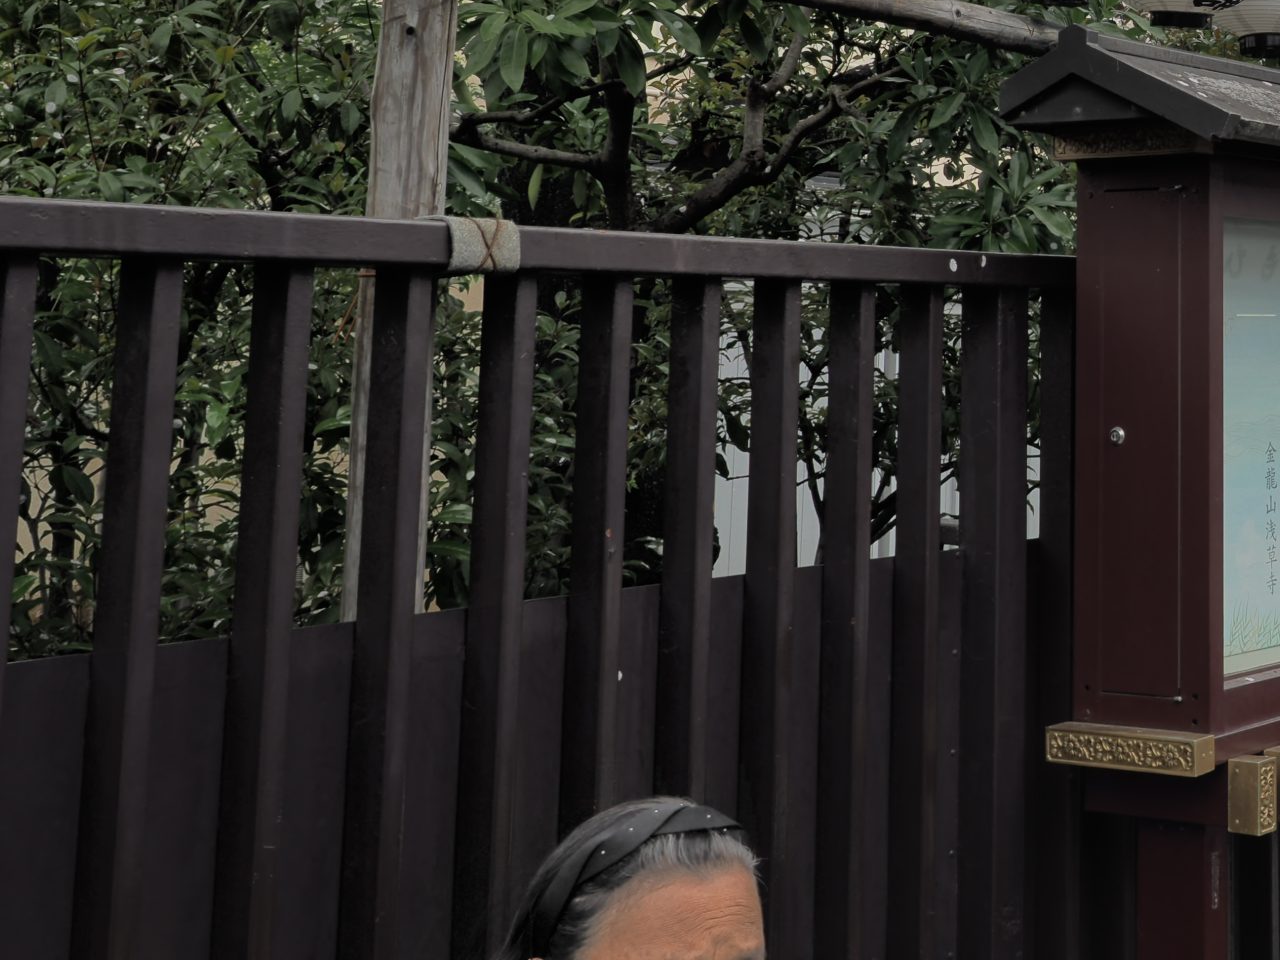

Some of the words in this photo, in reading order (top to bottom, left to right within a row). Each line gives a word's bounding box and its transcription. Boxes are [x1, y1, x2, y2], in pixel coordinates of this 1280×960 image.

[1264, 440, 1279, 596] 金龍山浅草寺
